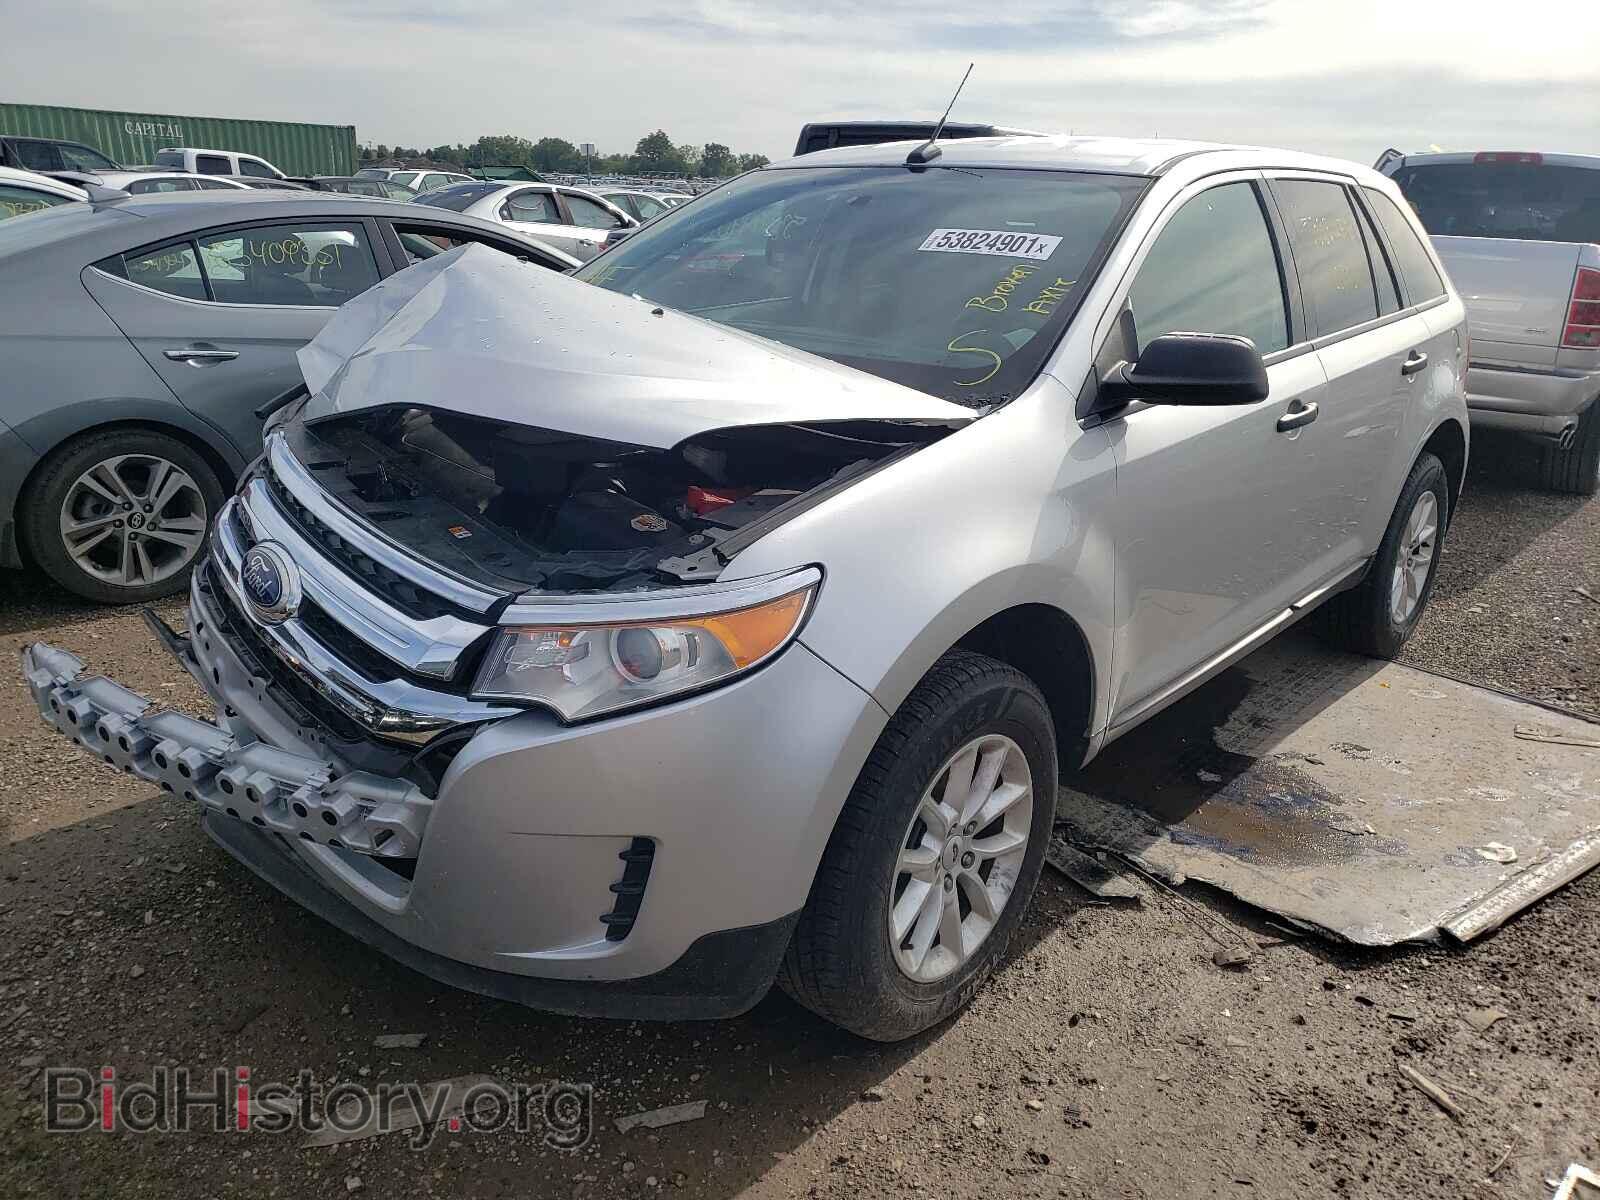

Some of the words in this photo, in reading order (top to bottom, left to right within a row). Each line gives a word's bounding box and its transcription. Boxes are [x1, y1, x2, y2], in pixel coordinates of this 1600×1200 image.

[124, 119, 184, 138] CAPITAL
[946, 328, 1002, 386] S
[243, 555, 273, 599] Ford
